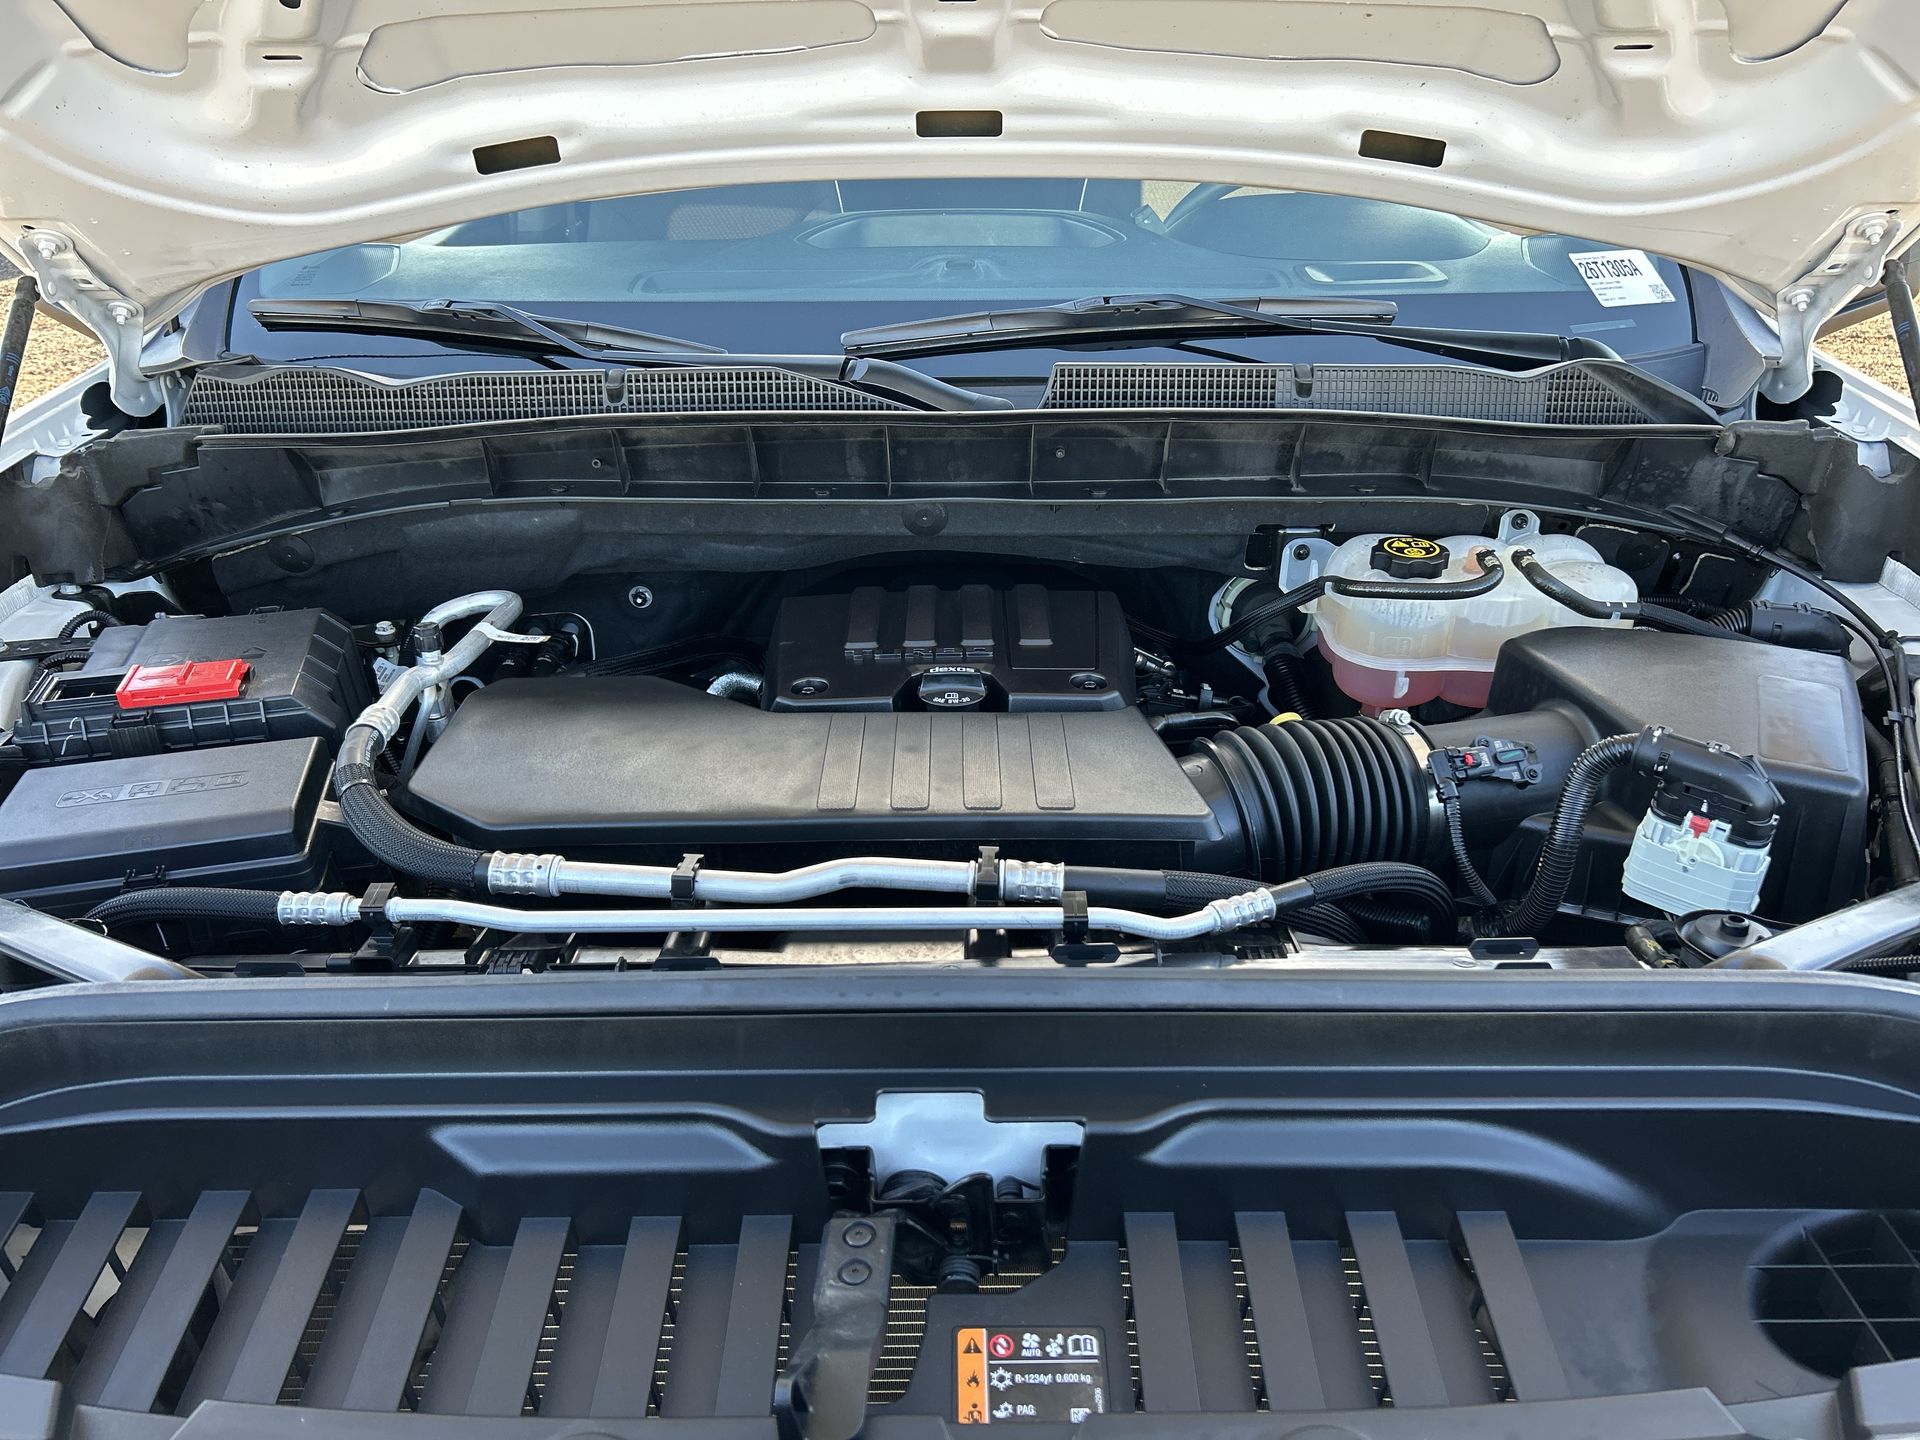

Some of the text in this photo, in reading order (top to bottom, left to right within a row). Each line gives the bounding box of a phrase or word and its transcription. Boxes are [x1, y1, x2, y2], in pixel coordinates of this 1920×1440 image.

[1578, 258, 1643, 279] 26T1305A
[1021, 1349, 1042, 1357] AUTO
[1015, 1373, 1091, 1384] R-1234yf 0.600 kg
[1017, 1405, 1036, 1415] PAG
